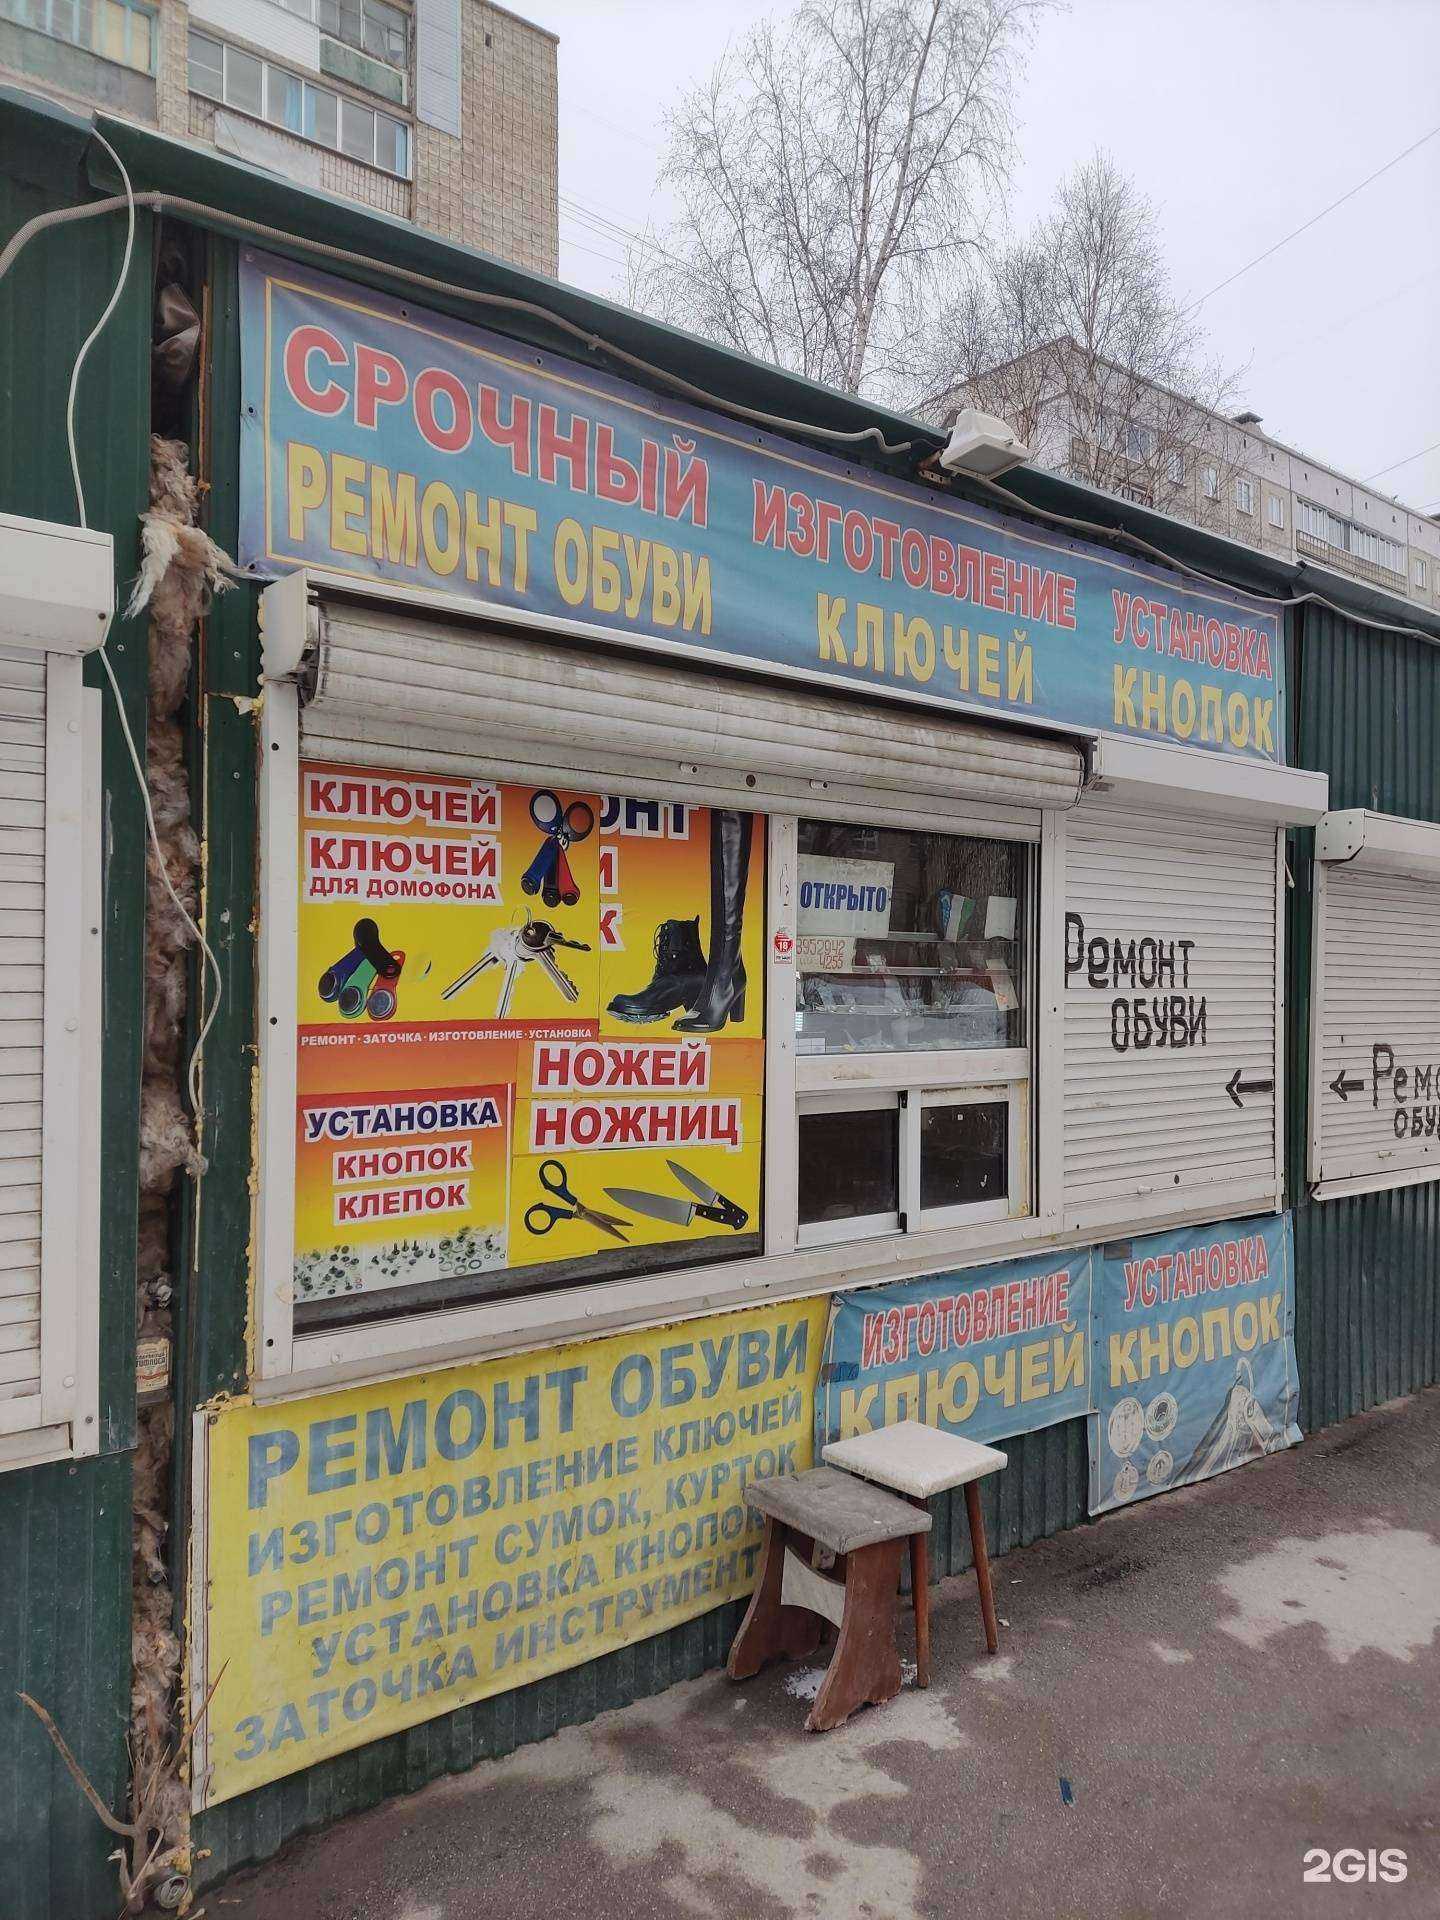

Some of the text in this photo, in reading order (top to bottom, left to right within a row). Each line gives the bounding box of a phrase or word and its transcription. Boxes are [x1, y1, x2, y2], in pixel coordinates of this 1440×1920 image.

[283, 325, 709, 528] СРОЧНЫЙ
[287, 442, 712, 636] РЕМОНТ ОБУВИ
[752, 479, 1077, 630] ИЗГОТОВЛЕНИЕ
[816, 592, 1033, 705] КЛЮЧЕЙ
[1111, 589, 1273, 680] УСТАНОВКА
[1112, 663, 1275, 753] КНОПОК
[310, 780, 496, 825] КЛЮЧЕЙ
[310, 836, 496, 876] КЛЮЧЕЙ
[310, 877, 497, 900] ДЛЯ ДОМОФОНА
[800, 881, 887, 912] ОТКРЫТО
[301, 1028, 592, 1046] РЕМОНТ ЗАТОЧКА ИЗГОТОВЛЕНИЕ УСТАНОВКА
[538, 1043, 706, 1086] НОЖЕЙ
[309, 1102, 498, 1138] УСТАНОВКА
[338, 1144, 468, 1180] КНОПОК
[534, 1103, 738, 1145] НОЖНИЦ
[338, 1184, 465, 1220] КЛЕПОК
[1124, 1234, 1269, 1313] УСТАНОВКА
[862, 1272, 1070, 1371] ИЗГОТОВЛЕНИЕ
[1109, 1291, 1283, 1388] КНОПОК
[247, 1319, 810, 1510] РЕМОНТ ОБУВИ
[247, 1386, 802, 1577] ИЗГОТОВЛЕНИЕ КЛЮЧЕЙ
[261, 1440, 796, 1637] РЕМОНТ СУМОК, КУРТОК
[233, 1542, 763, 1762] ЗАТОЧКА ИНСТРУМЕНТ
[312, 1552, 602, 1678] УСТАНОВКА
